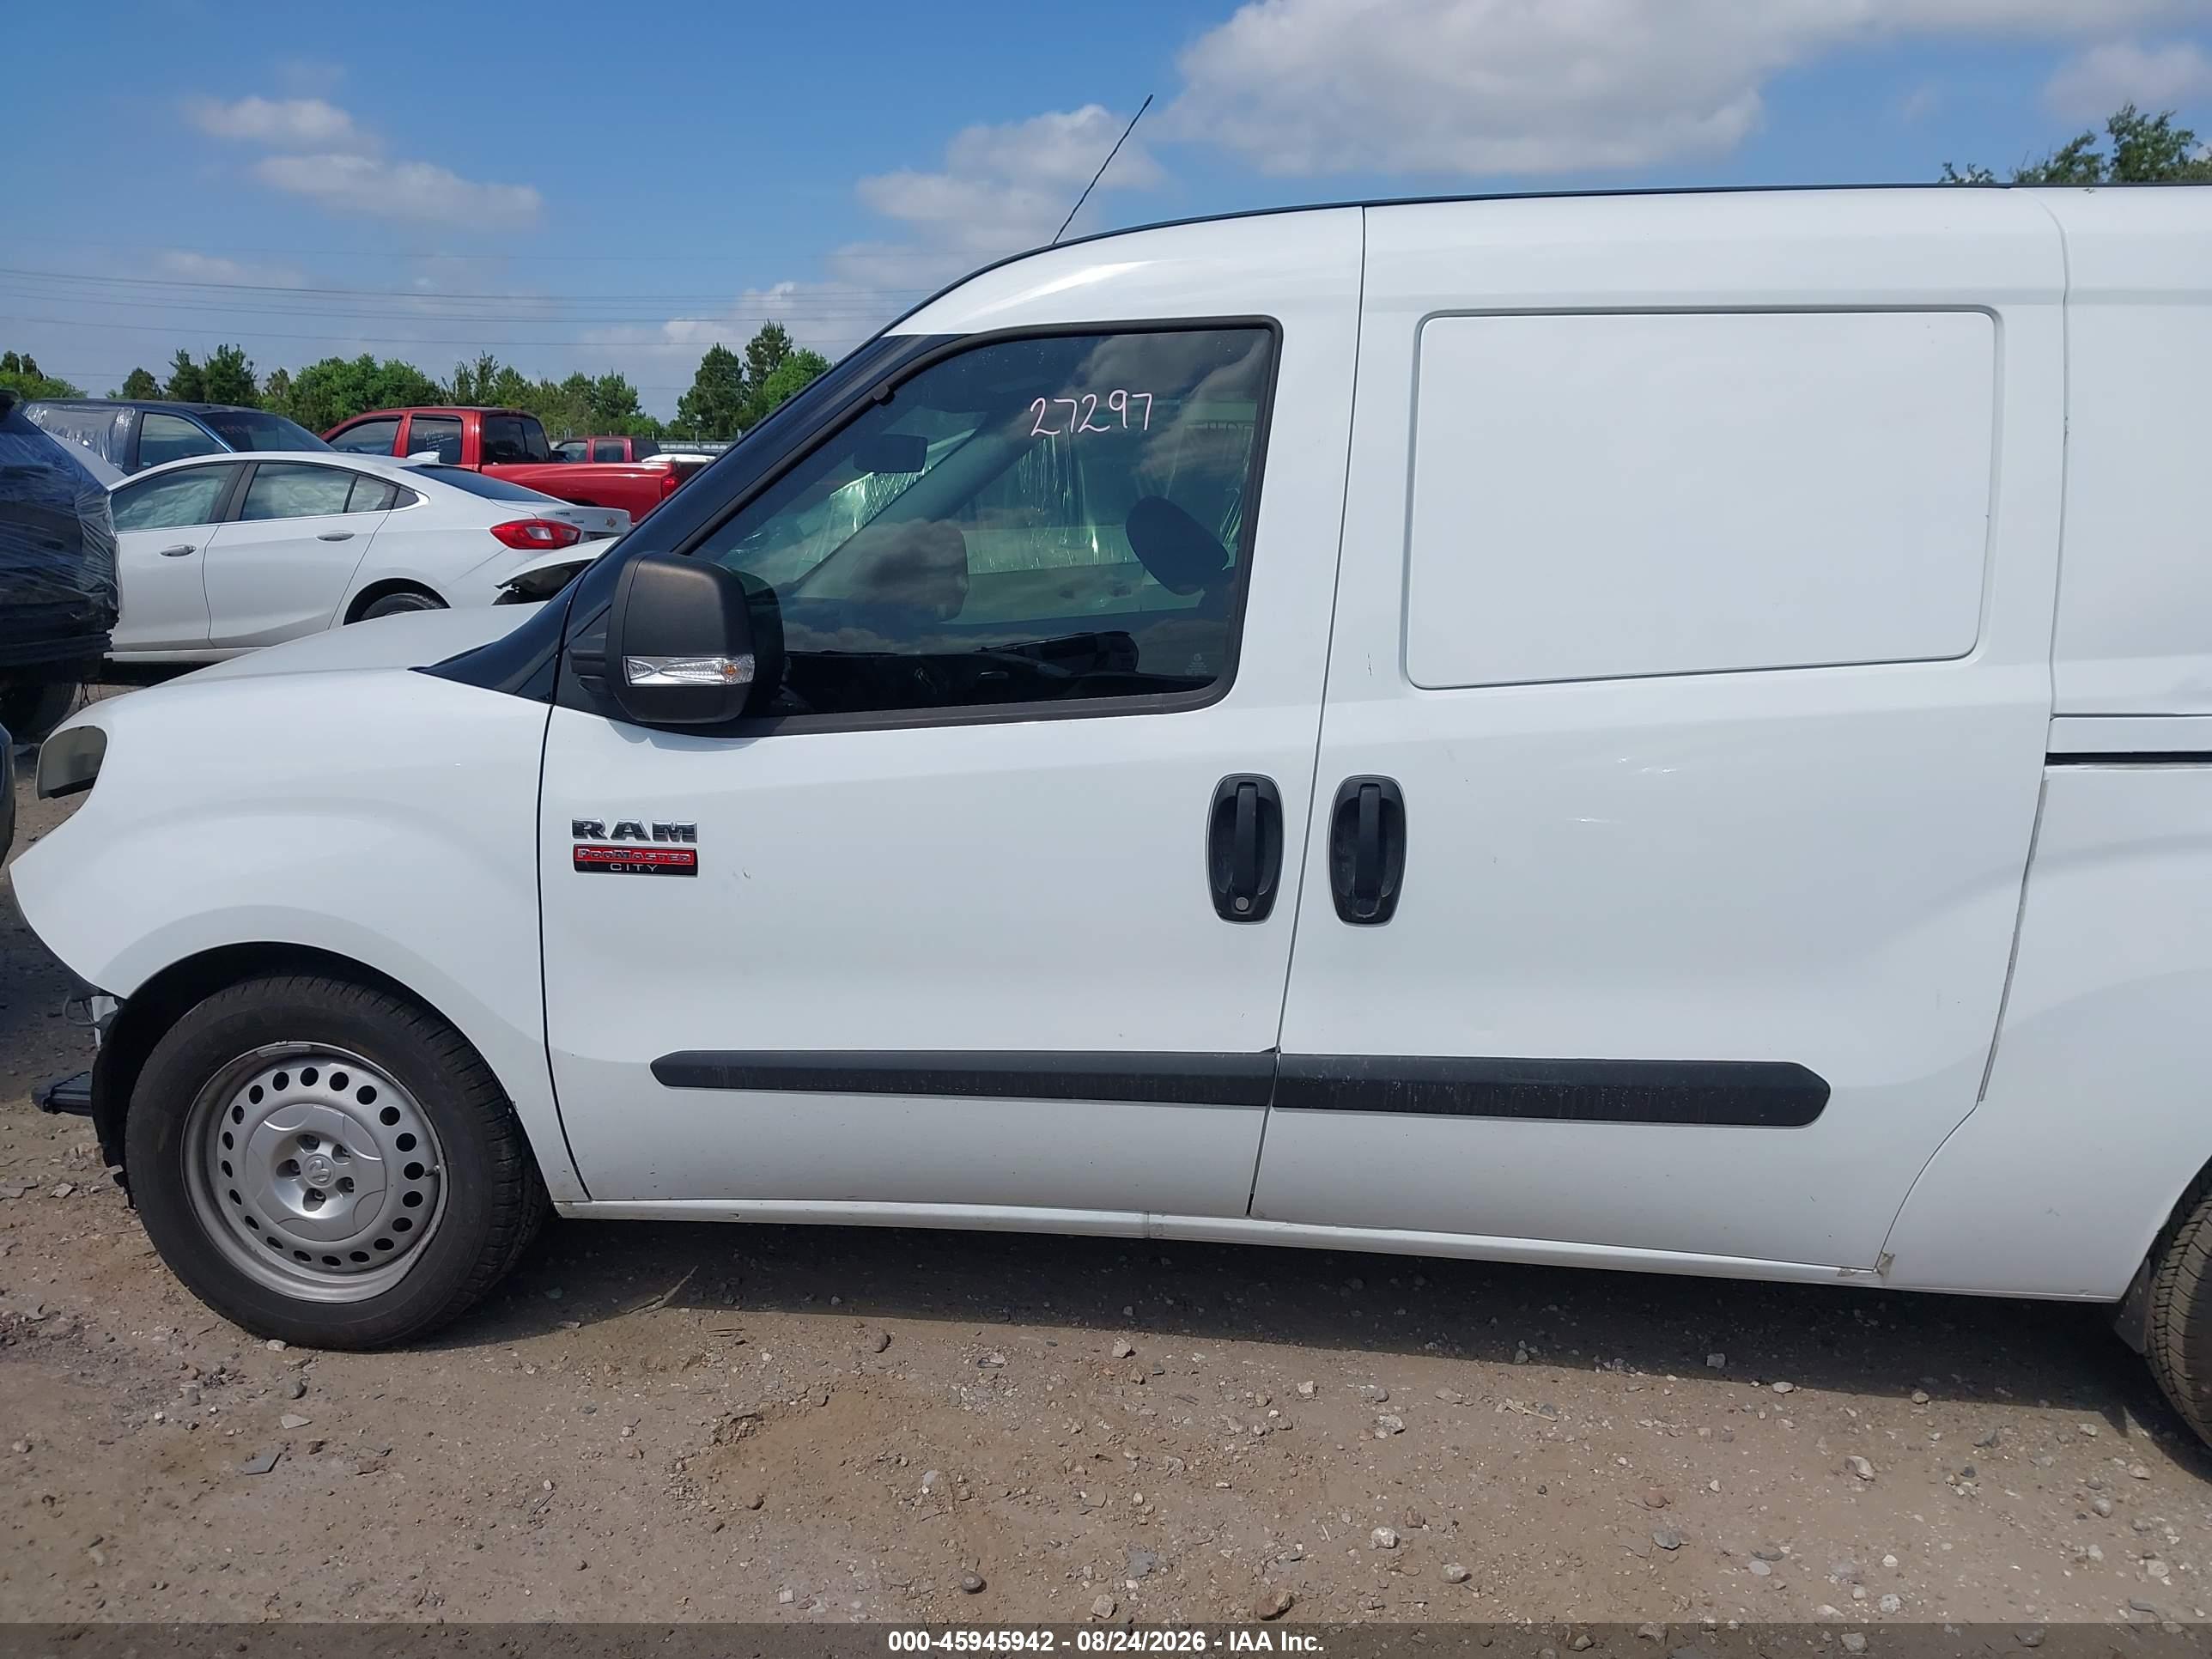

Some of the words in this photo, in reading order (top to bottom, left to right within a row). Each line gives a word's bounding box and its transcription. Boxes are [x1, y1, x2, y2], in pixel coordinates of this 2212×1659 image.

[1030, 389, 1153, 437] 27297
[572, 818, 698, 843] RAM
[577, 848, 692, 863] PROMASTER
[610, 863, 659, 872] CITY
